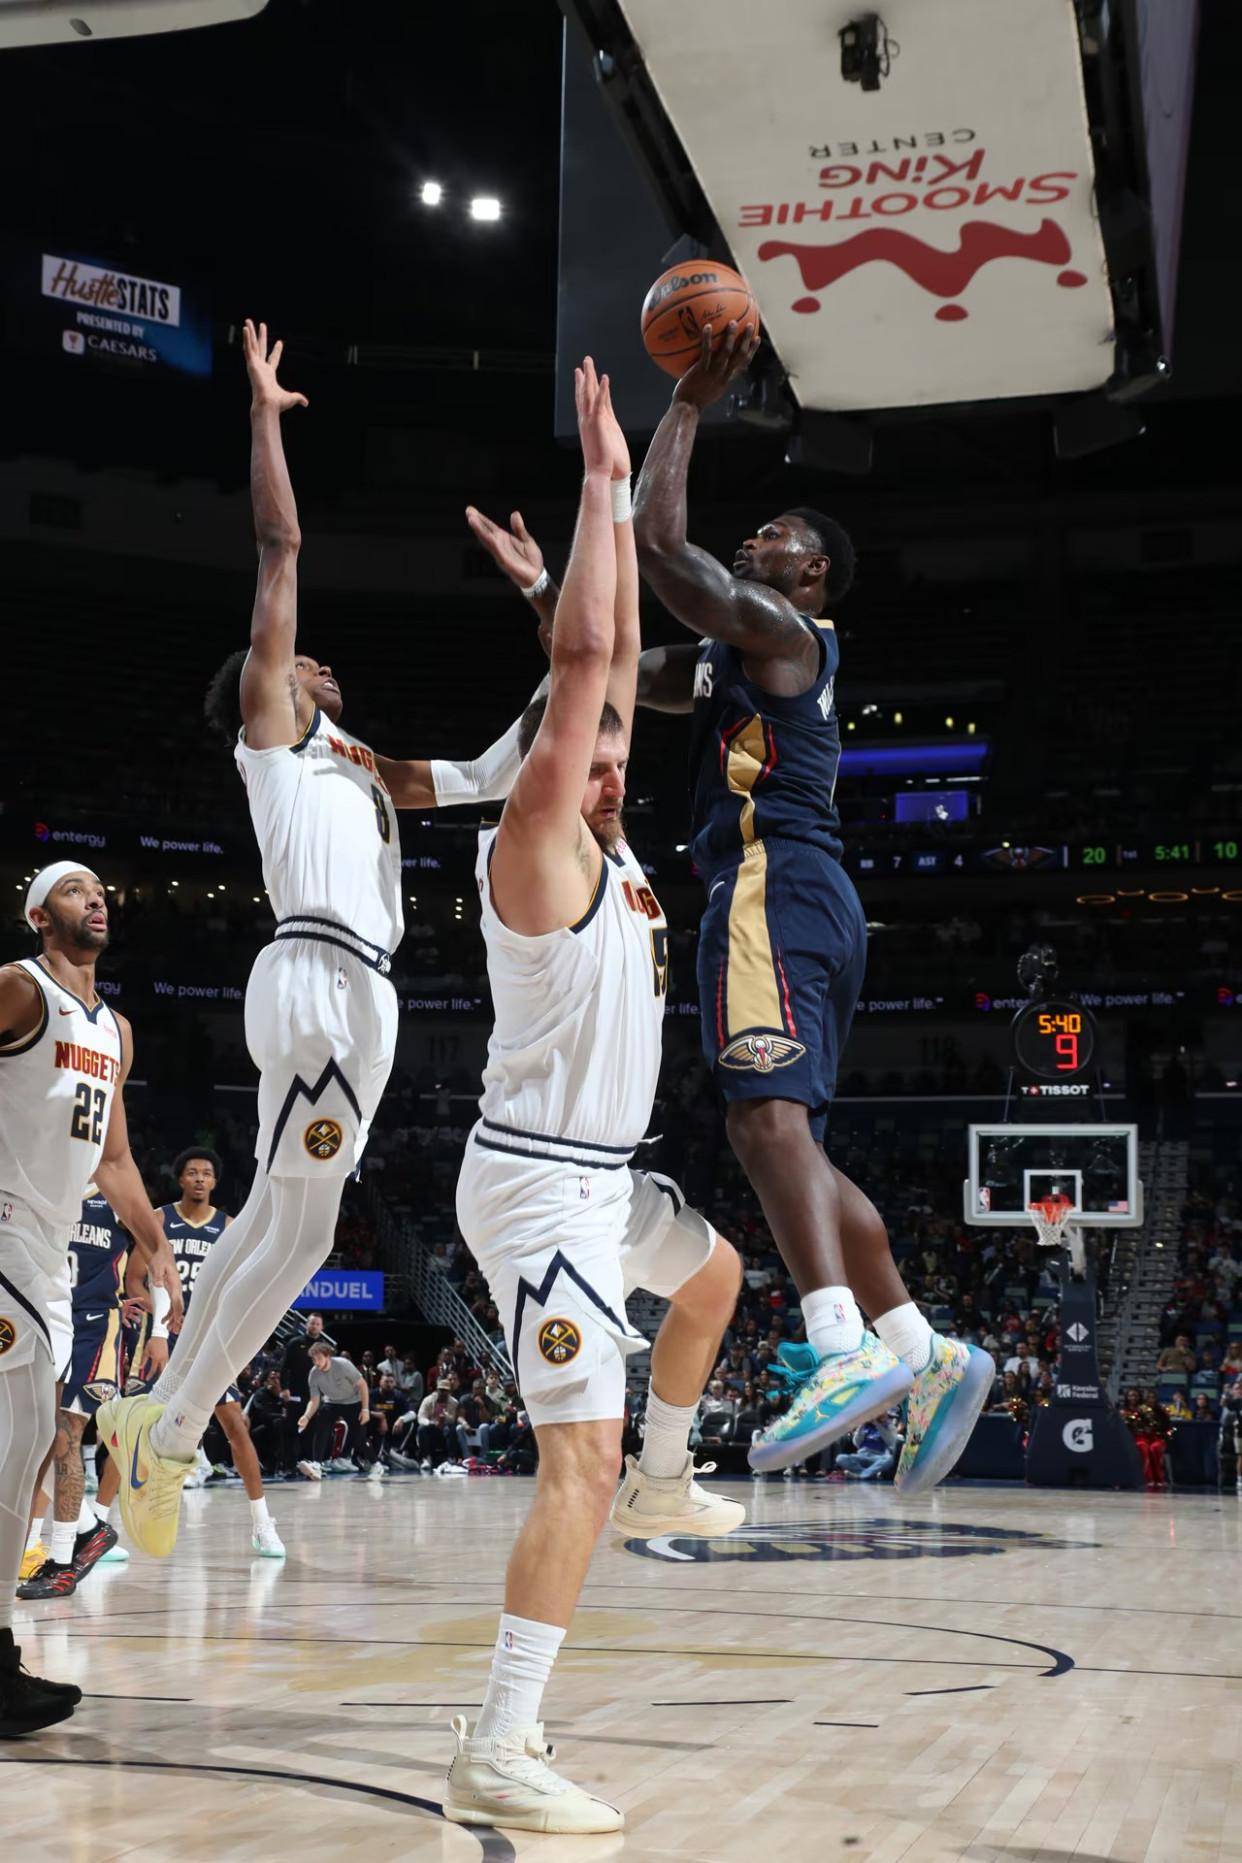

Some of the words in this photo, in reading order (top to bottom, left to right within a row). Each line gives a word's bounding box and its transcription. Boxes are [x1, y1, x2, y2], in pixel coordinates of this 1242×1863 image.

[809, 128, 976, 158] CENTER
[738, 172, 1078, 227] SMOOTHIE
[76, 311, 131, 336] PRESENTED
[132, 324, 146, 340] BY
[87, 334, 158, 363] CAESARS
[52, 831, 106, 848] entergy
[140, 835, 160, 848] We
[162, 841, 200, 853] power
[202, 842, 224, 854] life.
[892, 856, 902, 869] 7
[953, 854, 964, 867] 4
[1083, 846, 1106, 864] 20
[1154, 845, 1190, 861] 5:41
[1214, 841, 1238, 859] 10
[420, 856, 441, 869] life.
[154, 981, 174, 995] We
[178, 986, 219, 998] power
[223, 987, 245, 1000] life.
[1079, 992, 1102, 1006] We
[1105, 993, 1149, 1008] power
[408, 999, 448, 1011] power
[868, 1000, 911, 1014] power
[1038, 1014, 1081, 1034] 5:40
[1056, 1034, 1078, 1070] 9
[1039, 1084, 1090, 1096] TISSOT
[70, 1082, 107, 1146] 22
[70, 1222, 112, 1249] RLEANS
[301, 1281, 374, 1299] NDUEL
[1062, 1418, 1094, 1453] G
